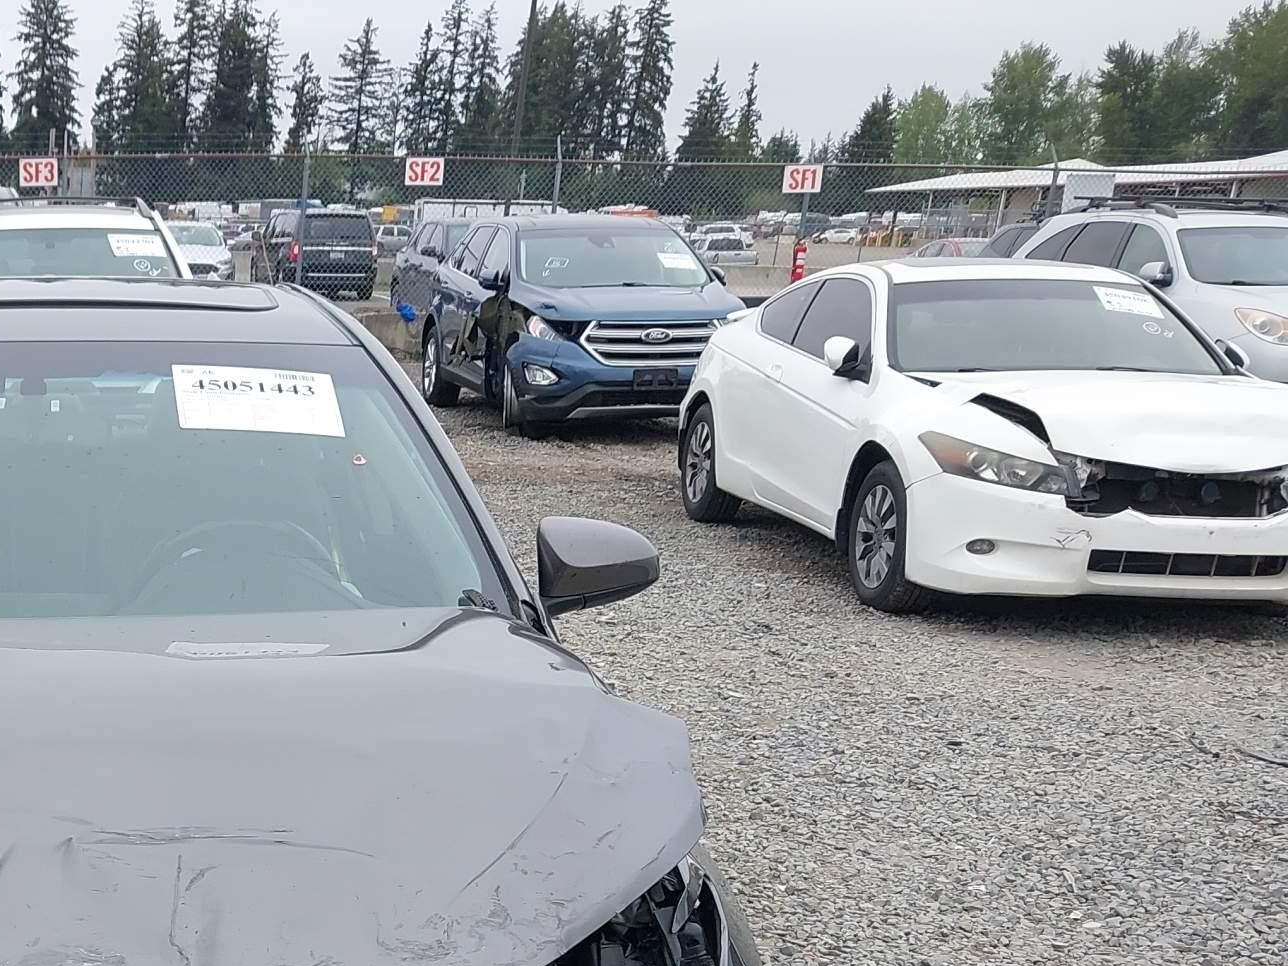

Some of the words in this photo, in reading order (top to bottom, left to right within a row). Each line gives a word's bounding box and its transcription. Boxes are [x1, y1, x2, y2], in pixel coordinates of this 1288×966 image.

[23, 161, 54, 182] SF3
[408, 161, 440, 182] SF2
[789, 168, 817, 190] SF1
[192, 379, 315, 397] 45051443
